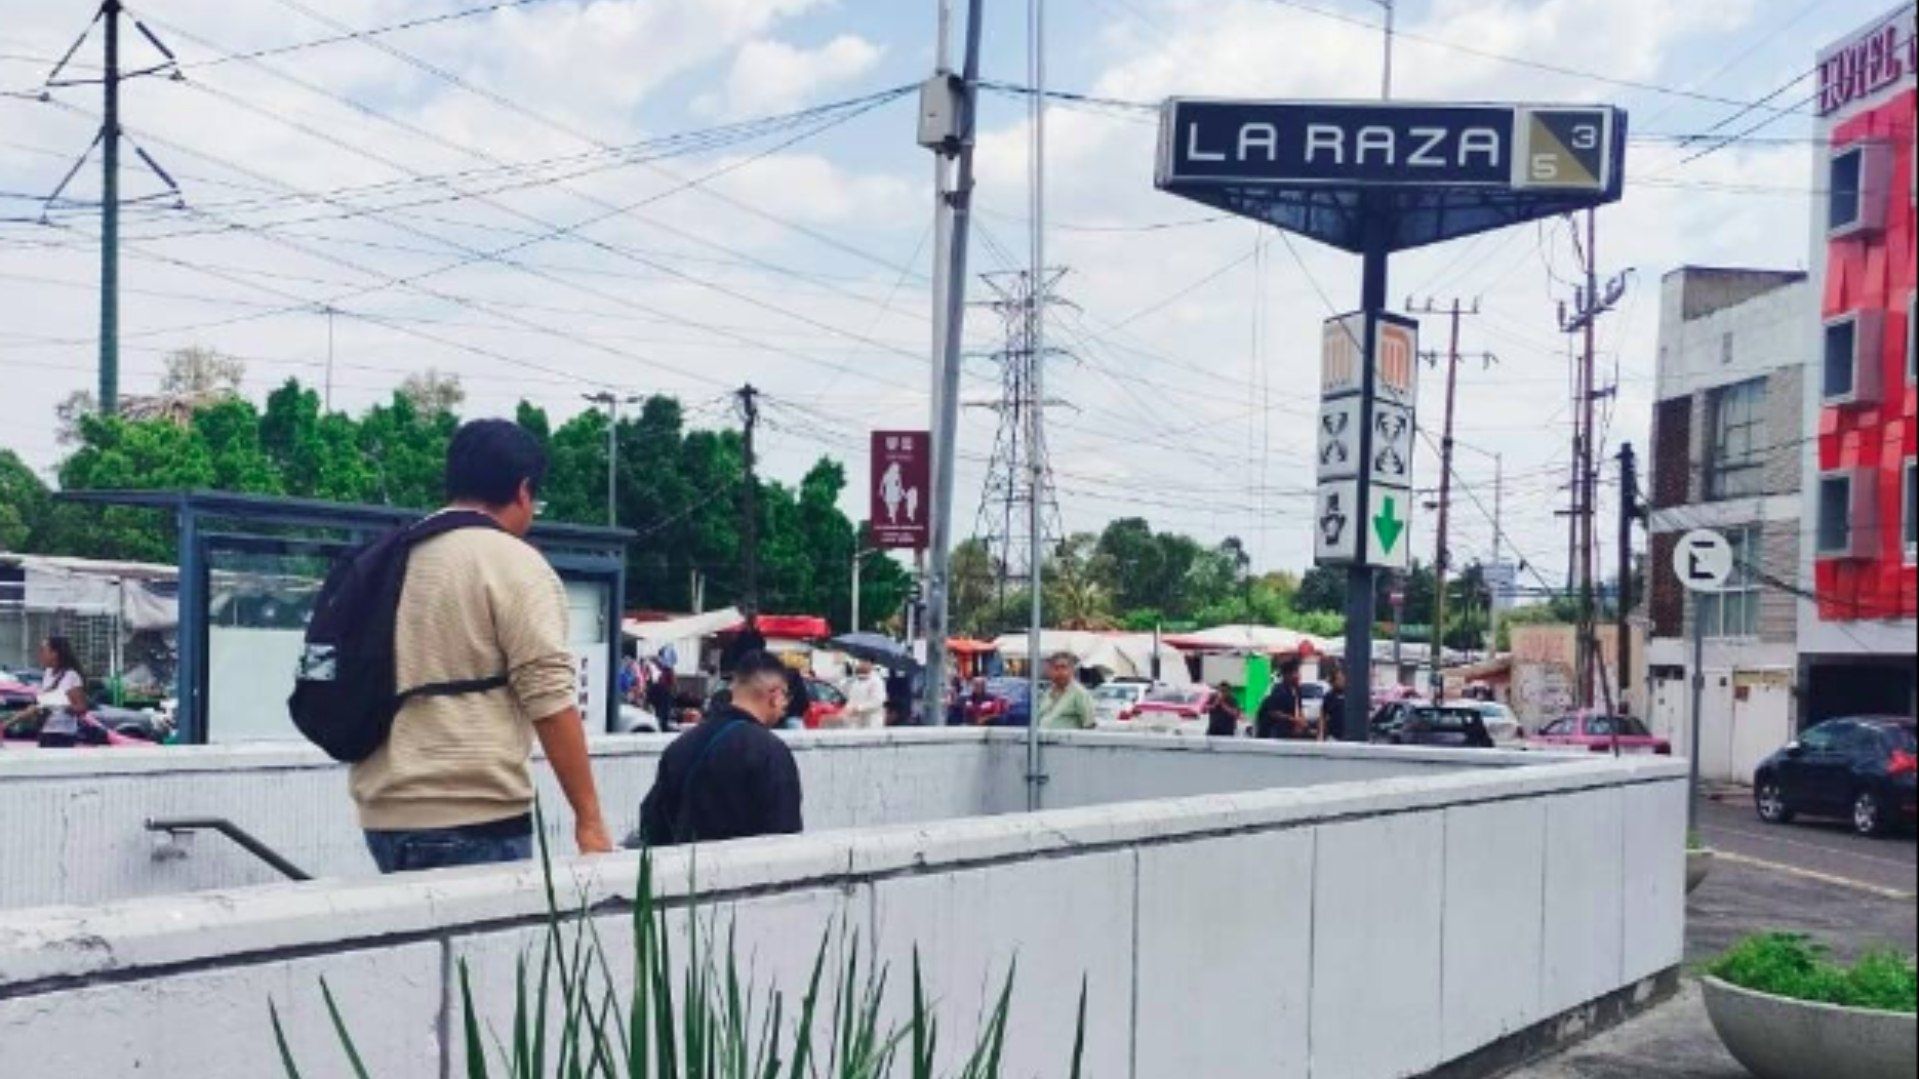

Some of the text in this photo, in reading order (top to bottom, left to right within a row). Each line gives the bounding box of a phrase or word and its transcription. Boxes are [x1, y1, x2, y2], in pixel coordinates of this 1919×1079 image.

[1819, 26, 1901, 117] HOTEL
[1187, 122, 1499, 167] LA RAZA
[1572, 125, 1598, 149] 3
[1532, 153, 1558, 179] 5
